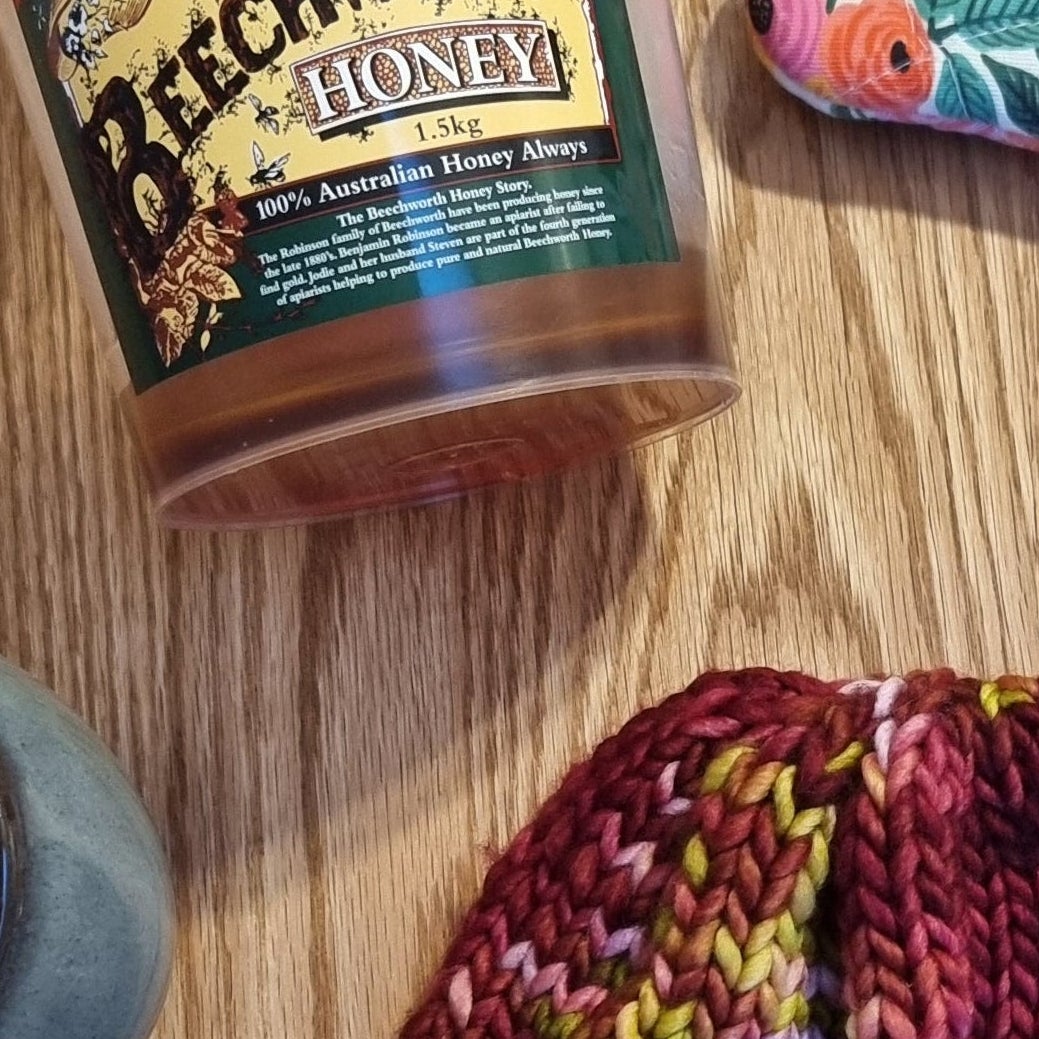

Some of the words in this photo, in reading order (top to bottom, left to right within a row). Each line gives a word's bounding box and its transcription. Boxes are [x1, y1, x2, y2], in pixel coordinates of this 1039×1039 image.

[303, 33, 542, 121] HONEY
[414, 115, 483, 142] 1.5kg
[255, 188, 312, 221] 100%
[318, 162, 434, 204] Australian
[440, 150, 514, 176] Honey
[521, 139, 588, 162] Always
[335, 213, 365, 228] The
[365, 191, 448, 221] Beechworth
[449, 185, 493, 203] Honey
[495, 179, 532, 194] Story.
[257, 252, 278, 266] The
[280, 240, 330, 259] Robinson
[331, 228, 366, 245] family
[368, 223, 380, 236] of
[382, 209, 446, 233] Beechworth
[447, 206, 473, 218] have
[474, 200, 500, 213] been
[502, 192, 553, 212] producing
[553, 187, 580, 201] honey
[582, 184, 604, 197] since
[259, 281, 281, 297] find
[282, 275, 308, 290] gold.
[308, 267, 335, 285] Jodie
[337, 260, 358, 274] and
[360, 255, 378, 268] her
[380, 242, 426, 264] husband
[427, 237, 463, 252] Steven
[466, 234, 482, 245] are
[484, 229, 506, 244] part
[508, 224, 520, 236] of
[521, 221, 538, 235] the
[539, 216, 570, 231] fourth
[571, 212, 616, 230] generation
[264, 267, 281, 280] the
[282, 262, 301, 275] late
[338, 238, 391, 259] Benjamin
[392, 226, 444, 245] Robinson
[446, 219, 487, 234] became
[489, 215, 502, 226] an
[504, 206, 541, 225] apiarist
[543, 203, 565, 217] after
[566, 199, 596, 213] failing
[596, 199, 606, 209] to
[276, 293, 288, 306] of
[289, 284, 332, 306] apiarists
[333, 272, 375, 290] helping
[375, 269, 388, 280] to
[390, 257, 434, 279] produce
[436, 252, 461, 269] pure
[463, 245, 484, 260] and
[485, 238, 522, 256] natural
[523, 231, 580, 249] Beechworth
